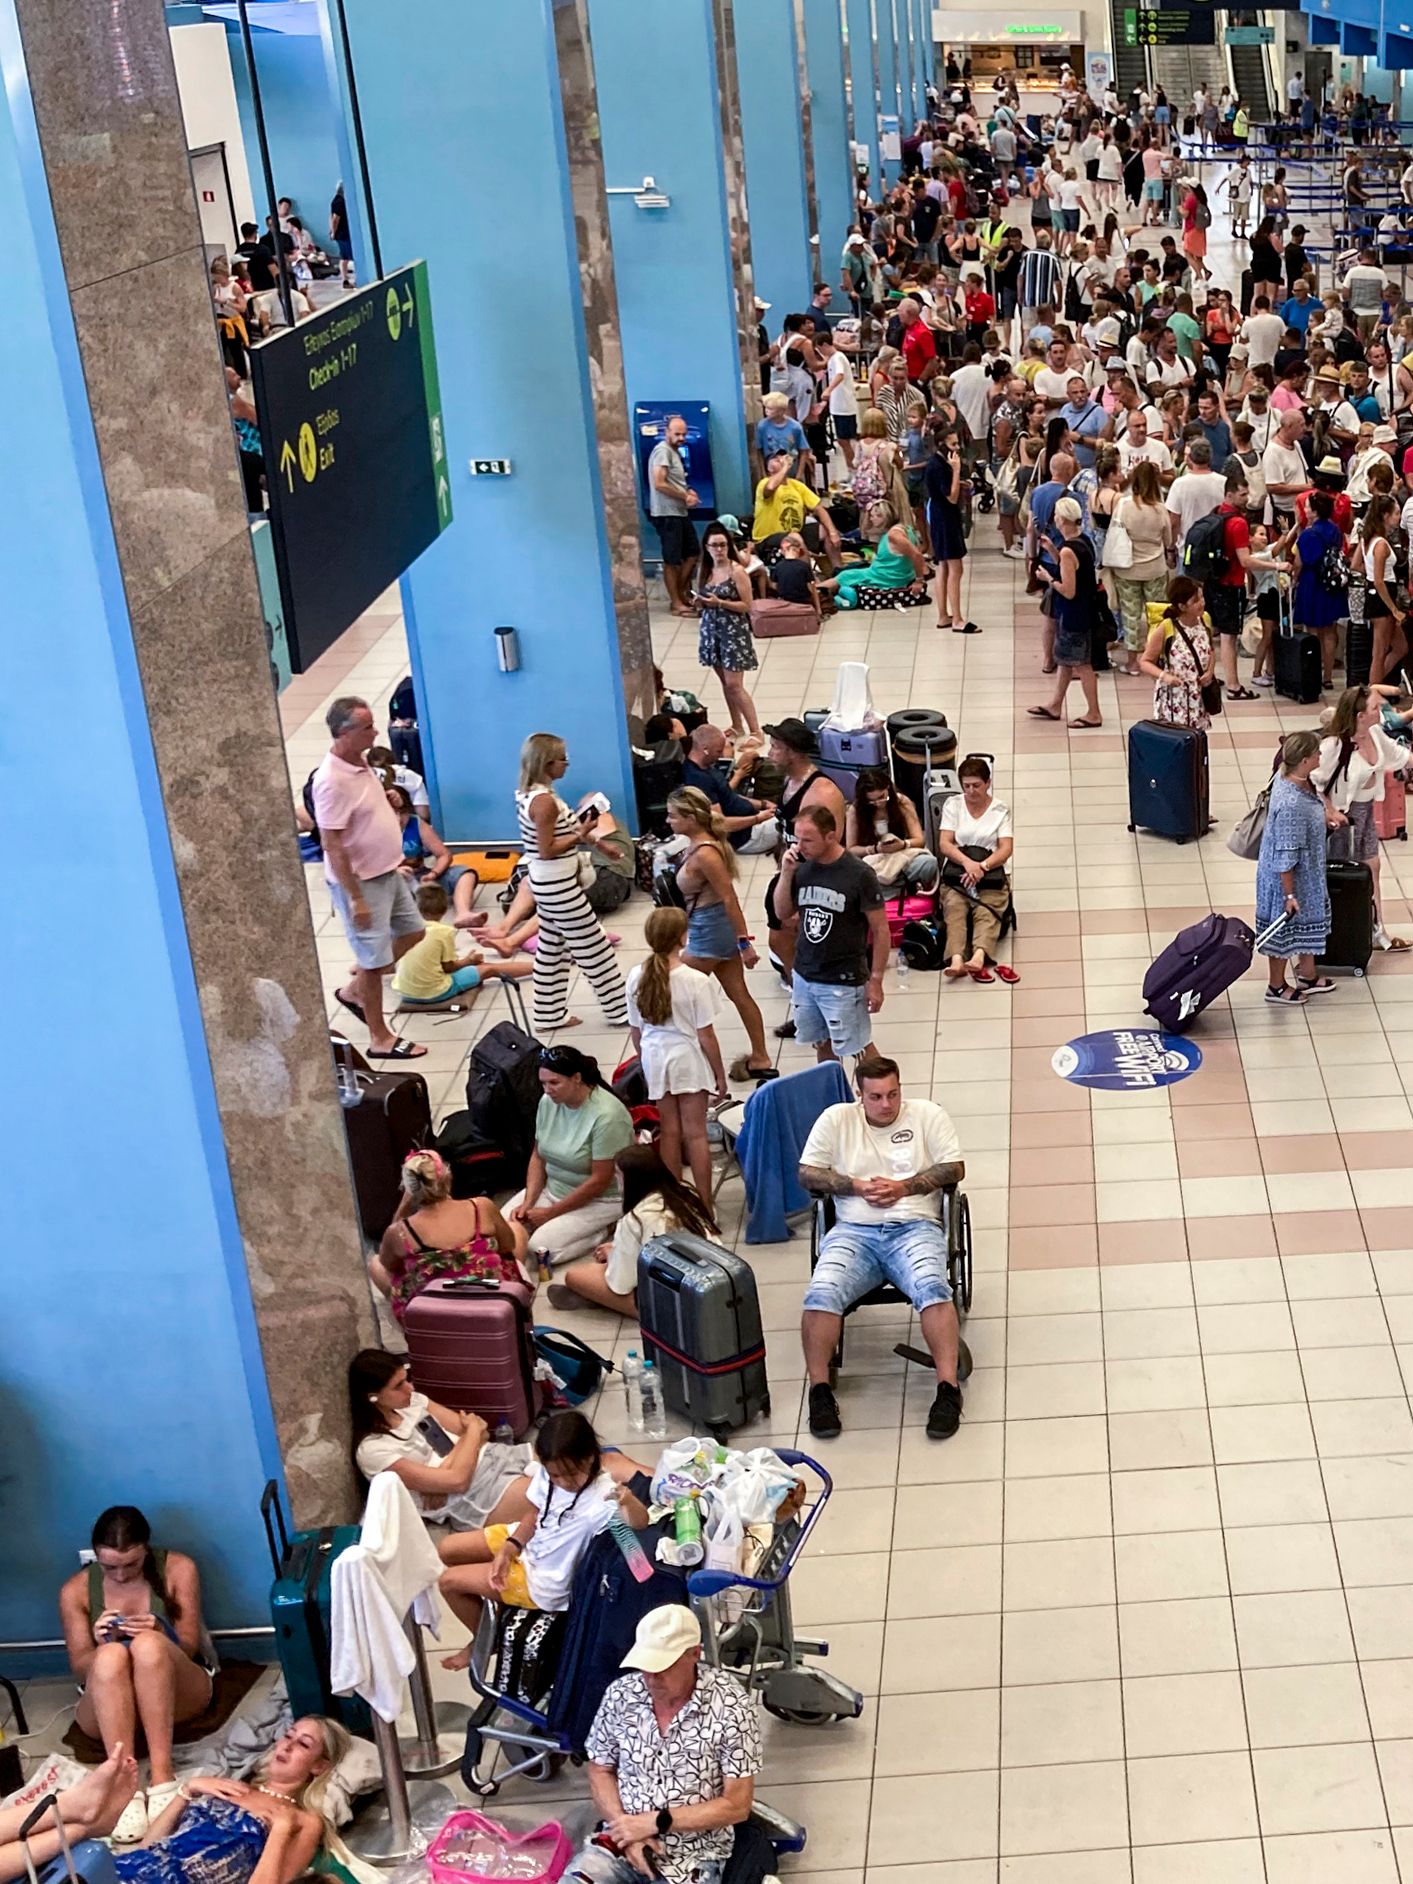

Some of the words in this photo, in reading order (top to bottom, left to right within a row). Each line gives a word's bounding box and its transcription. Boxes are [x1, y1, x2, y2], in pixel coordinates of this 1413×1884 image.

[309, 353, 340, 391] Check-in
[340, 343, 357, 372] 1-17
[320, 442, 335, 471] Exit
[798, 885, 847, 913] RAIDERS
[1112, 1031, 1141, 1056] FREE
